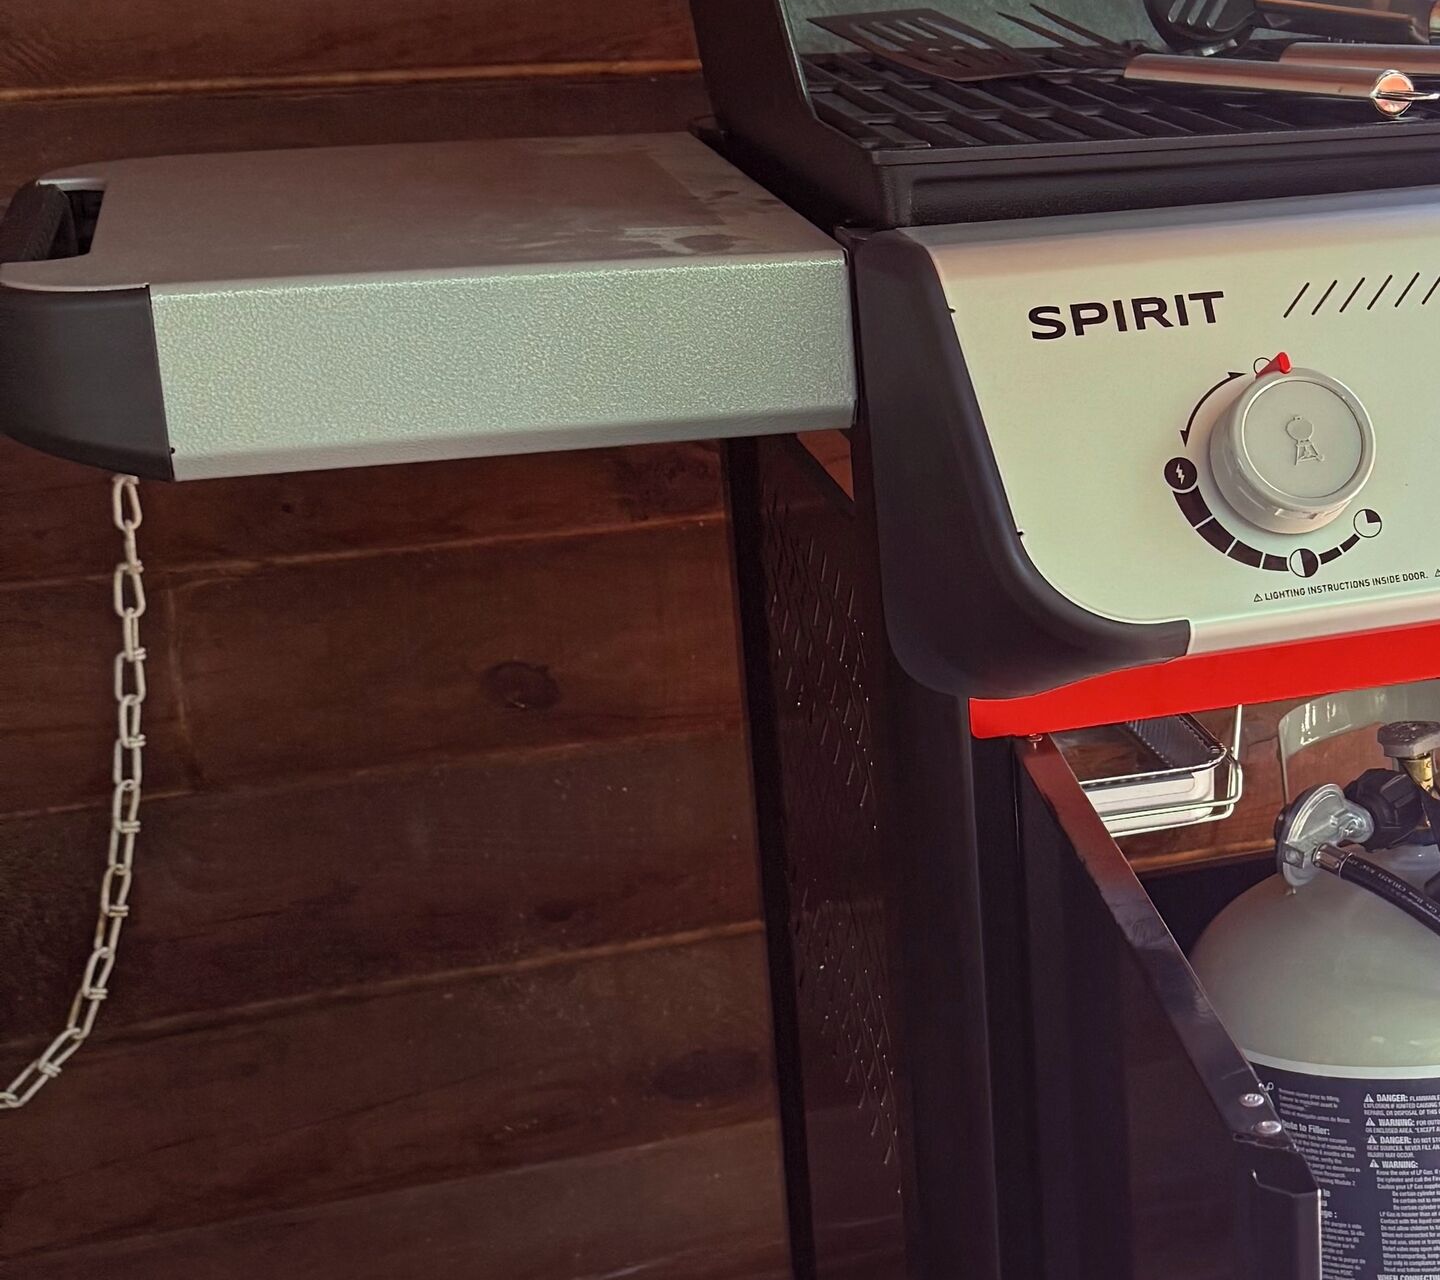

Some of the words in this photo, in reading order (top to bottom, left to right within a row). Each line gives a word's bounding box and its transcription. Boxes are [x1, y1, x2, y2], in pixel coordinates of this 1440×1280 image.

[1028, 291, 1225, 340] SPIRIT
[1264, 587, 1306, 602] LIGHTING
[1307, 578, 1371, 596] INSTRUCTIONS
[1372, 574, 1400, 586] INSIDE
[1402, 570, 1429, 582] DOOR.
[1377, 1094, 1408, 1102] DANGER:
[1378, 1118, 1415, 1126] WARNING:
[1380, 1136, 1412, 1144] DANGER:
[1382, 1160, 1418, 1168] WARNING:
